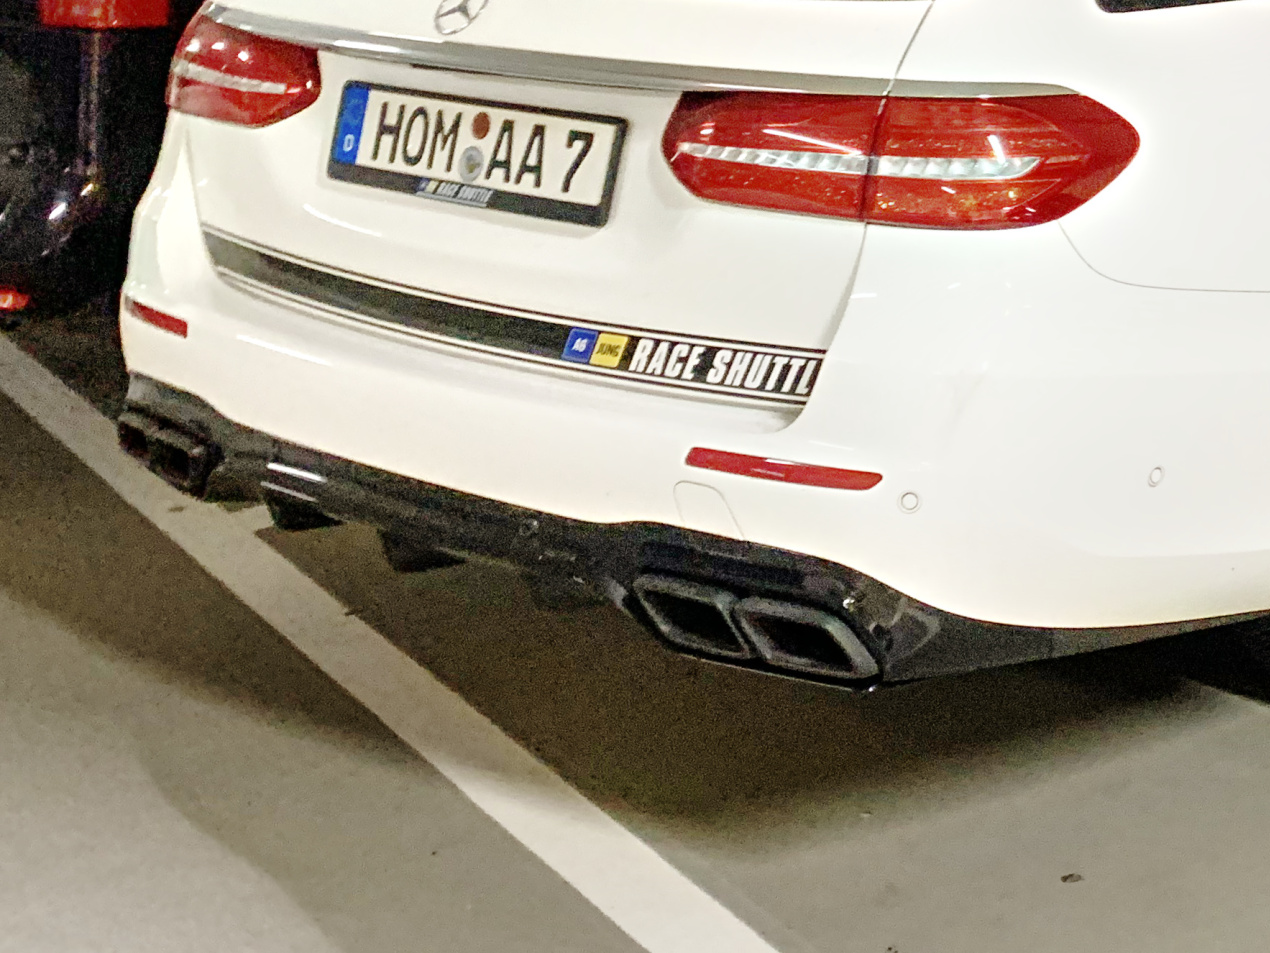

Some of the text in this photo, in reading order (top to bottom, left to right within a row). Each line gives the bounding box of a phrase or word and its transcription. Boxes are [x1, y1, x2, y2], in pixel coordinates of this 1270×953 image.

[370, 100, 463, 172] HOM
[485, 119, 546, 188] AA
[561, 129, 594, 193] 7
[627, 337, 706, 381] RACE
